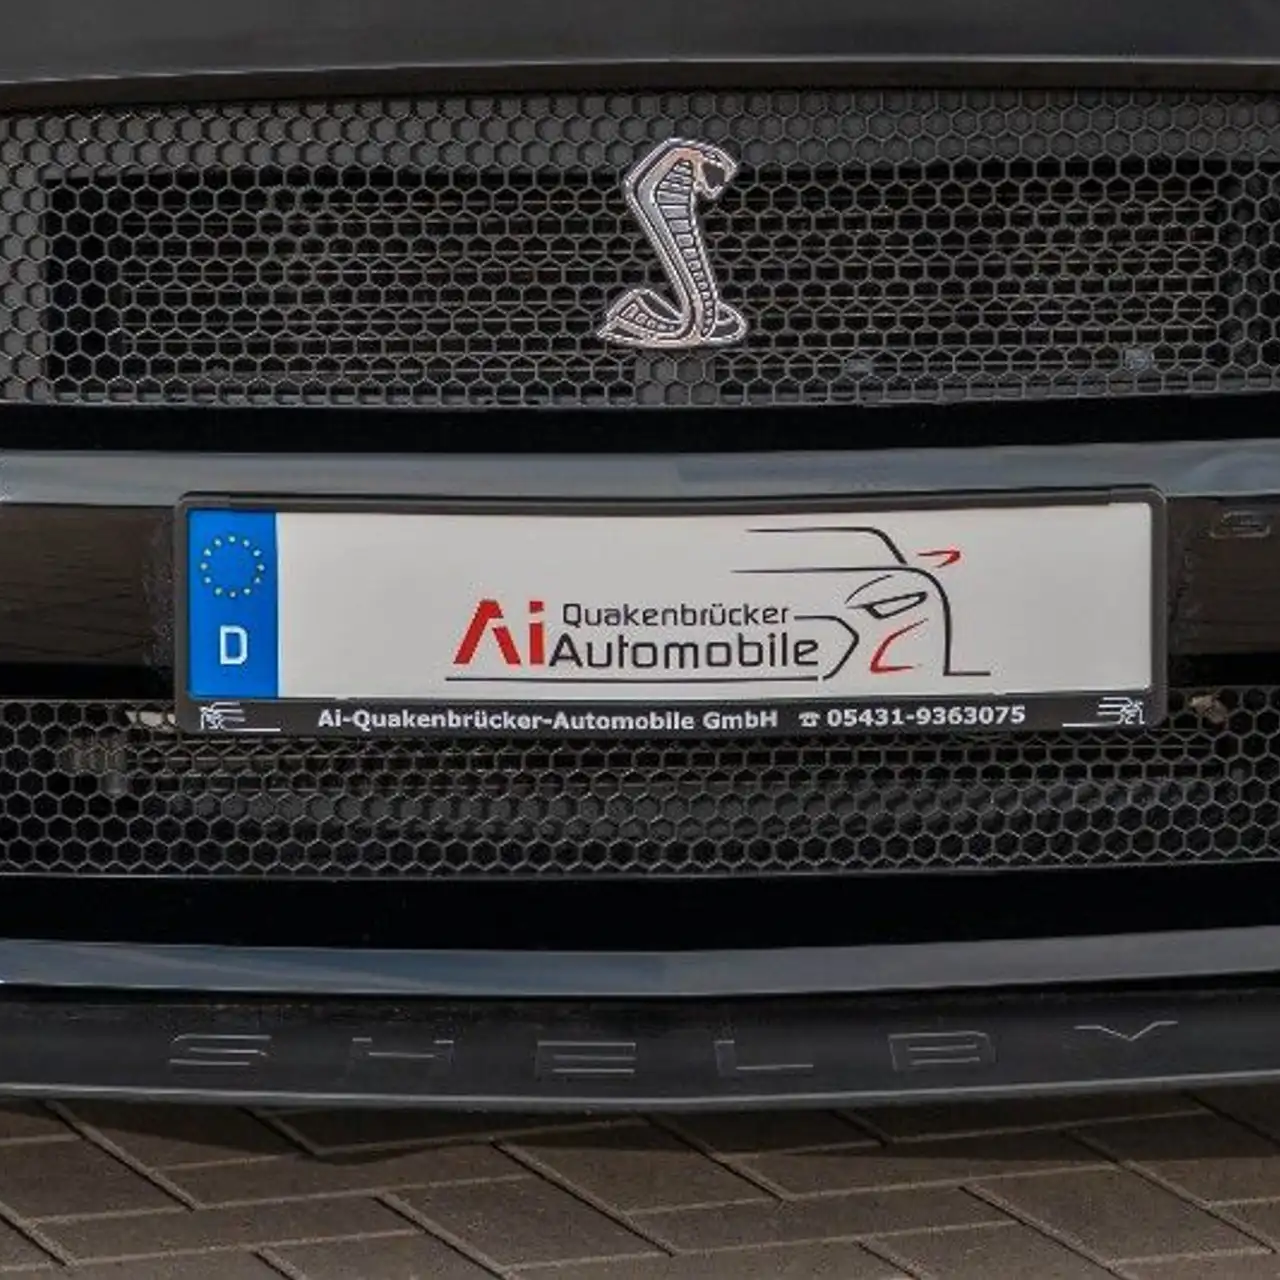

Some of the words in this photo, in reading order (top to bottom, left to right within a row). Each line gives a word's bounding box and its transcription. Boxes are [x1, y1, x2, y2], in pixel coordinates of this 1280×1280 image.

[453, 599, 545, 666] Ai
[563, 603, 789, 628] Quakenbrücker
[220, 626, 248, 666] D
[549, 633, 819, 669] Automobile
[318, 709, 694, 732] Ai-Quakenbrücker-Automobile
[703, 710, 778, 731] GmbH
[826, 705, 1026, 728] 05431-9363075
